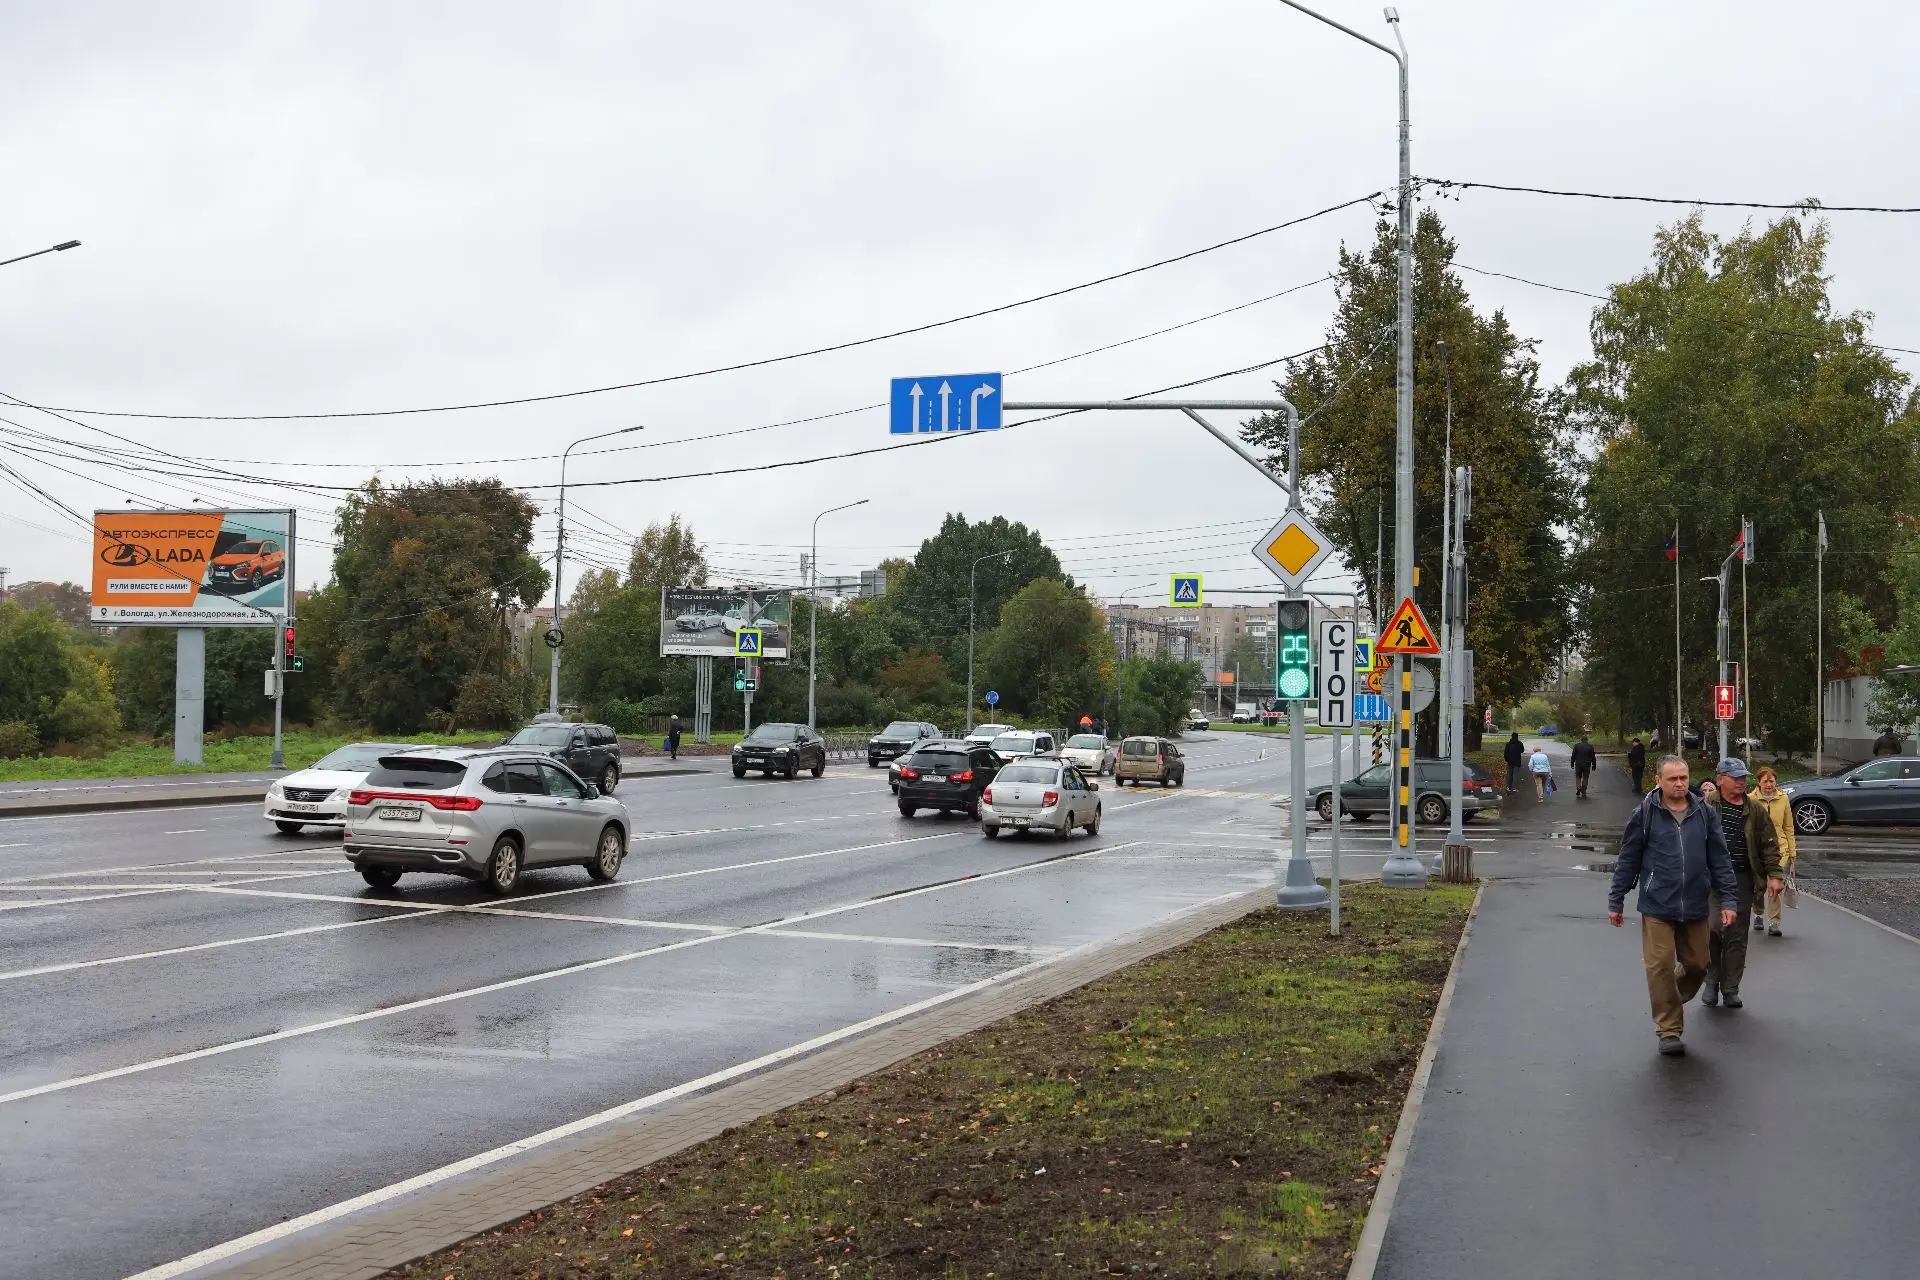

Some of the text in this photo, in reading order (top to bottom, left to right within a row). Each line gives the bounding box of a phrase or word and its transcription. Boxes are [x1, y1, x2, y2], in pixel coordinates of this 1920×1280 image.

[103, 530, 215, 539] АВТОЭКСПРЕСС
[155, 548, 205, 563] LADA
[1283, 635, 1309, 664] 25
[1328, 624, 1346, 723] СТОП
[1719, 703, 1732, 717] 80
